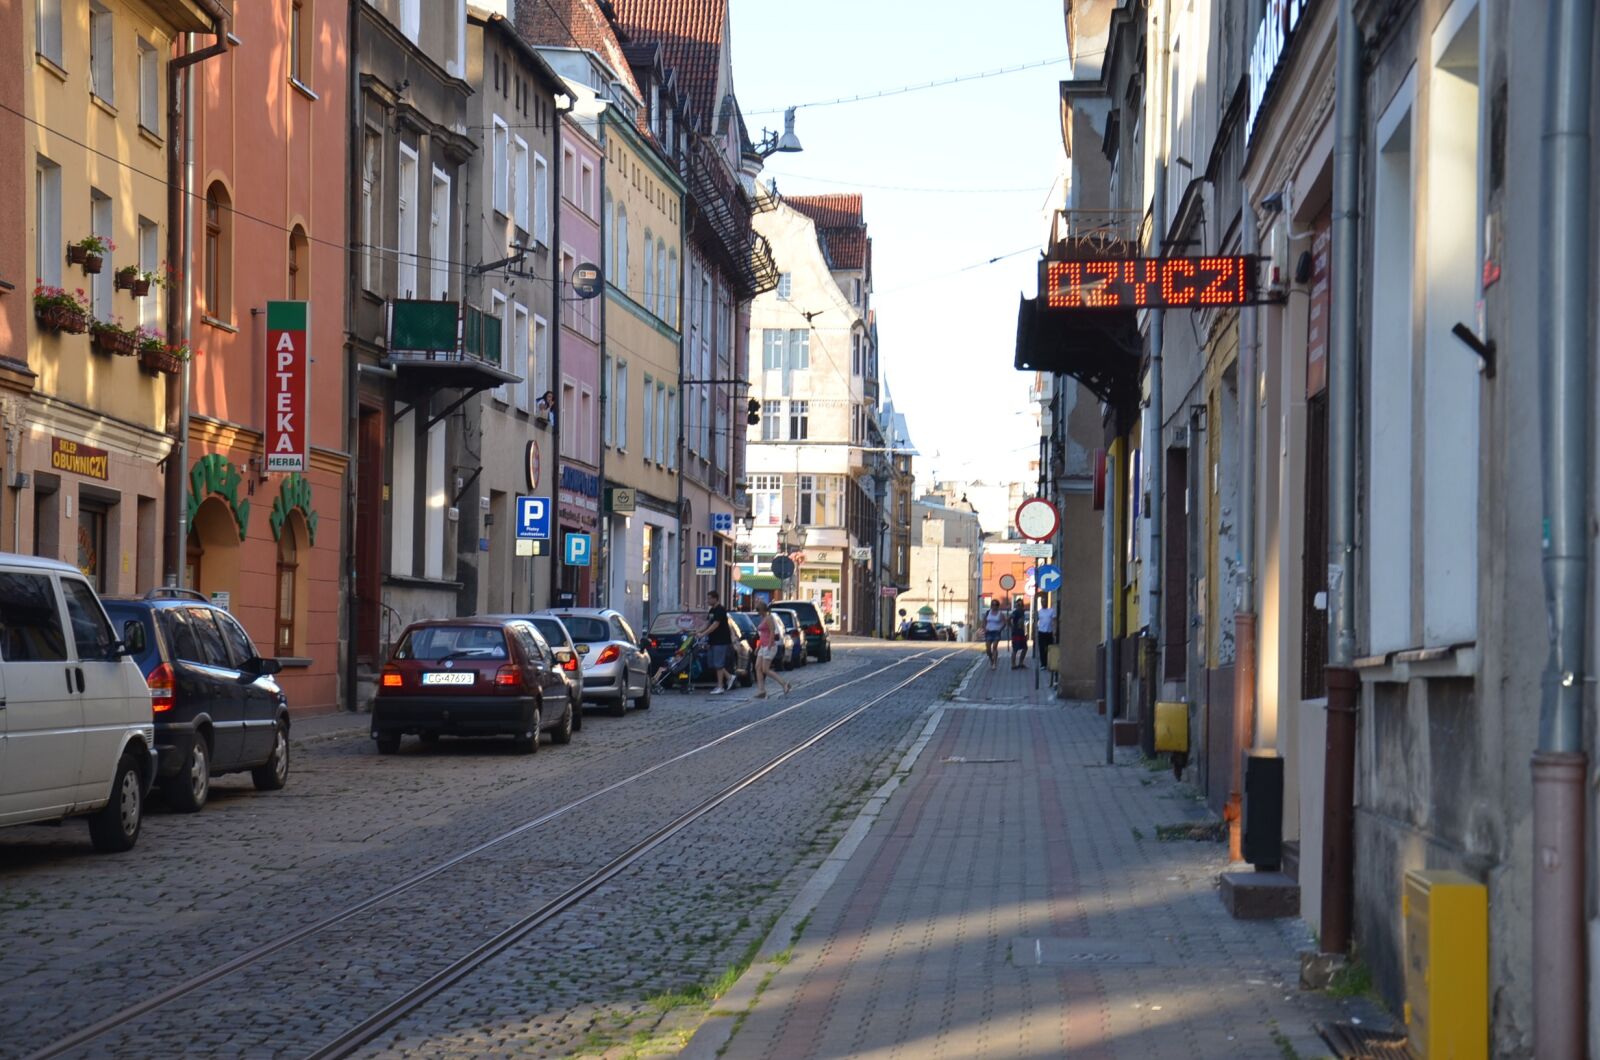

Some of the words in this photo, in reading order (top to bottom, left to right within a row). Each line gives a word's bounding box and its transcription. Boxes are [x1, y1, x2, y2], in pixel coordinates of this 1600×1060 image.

[275, 332, 294, 453] APTEKA
[53, 451, 107, 480] OBUWNICZY
[268, 458, 302, 467] HERBA
[524, 500, 543, 526] P
[571, 537, 586, 561] P
[700, 549, 712, 565] P
